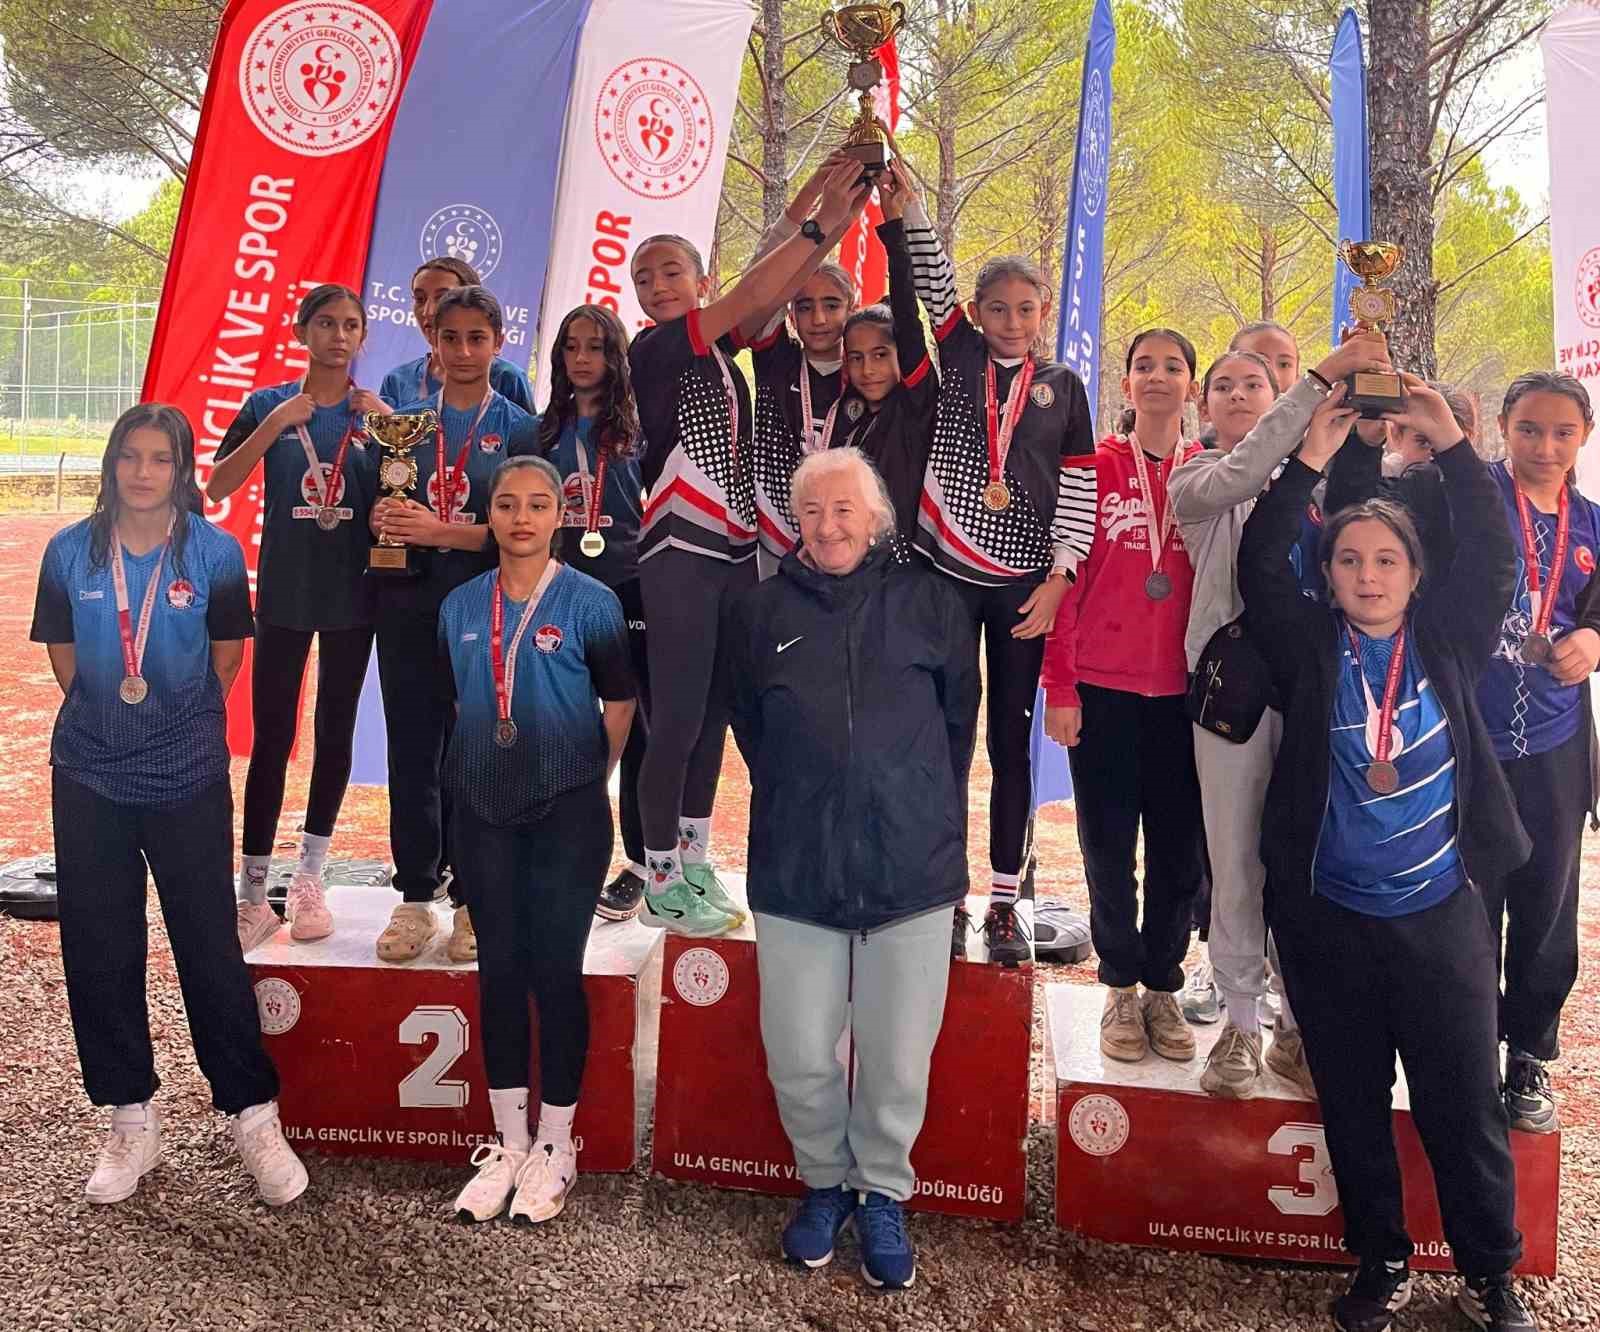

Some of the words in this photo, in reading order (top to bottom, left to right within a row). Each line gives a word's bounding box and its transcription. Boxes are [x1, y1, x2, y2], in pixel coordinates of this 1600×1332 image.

[316, 29, 355, 48] GENÇLİK
[234, 174, 295, 282] SPOR
[219, 289, 271, 339] VE
[367, 304, 417, 327] SPOR
[371, 282, 406, 303] T.C.
[505, 305, 528, 324] VE
[399, 1005, 470, 1107] 2
[285, 1126, 315, 1141] ULA
[318, 1127, 383, 1148] GENÇLİK
[386, 1130, 405, 1144] VE
[408, 1130, 449, 1146] SPOR
[452, 1130, 485, 1148] İLÇE
[673, 1152, 706, 1170] ULA
[710, 1157, 780, 1178] GENÇLİK
[911, 1177, 1003, 1204] ÜDÜRLÜĞÜ
[1267, 1121, 1338, 1216] 3
[1149, 1222, 1180, 1238] ULA
[1183, 1225, 1251, 1244] GENÇLİK
[1254, 1231, 1275, 1245] VE
[1278, 1232, 1321, 1248] SPOR
[1324, 1233, 1348, 1251] İLÇ
